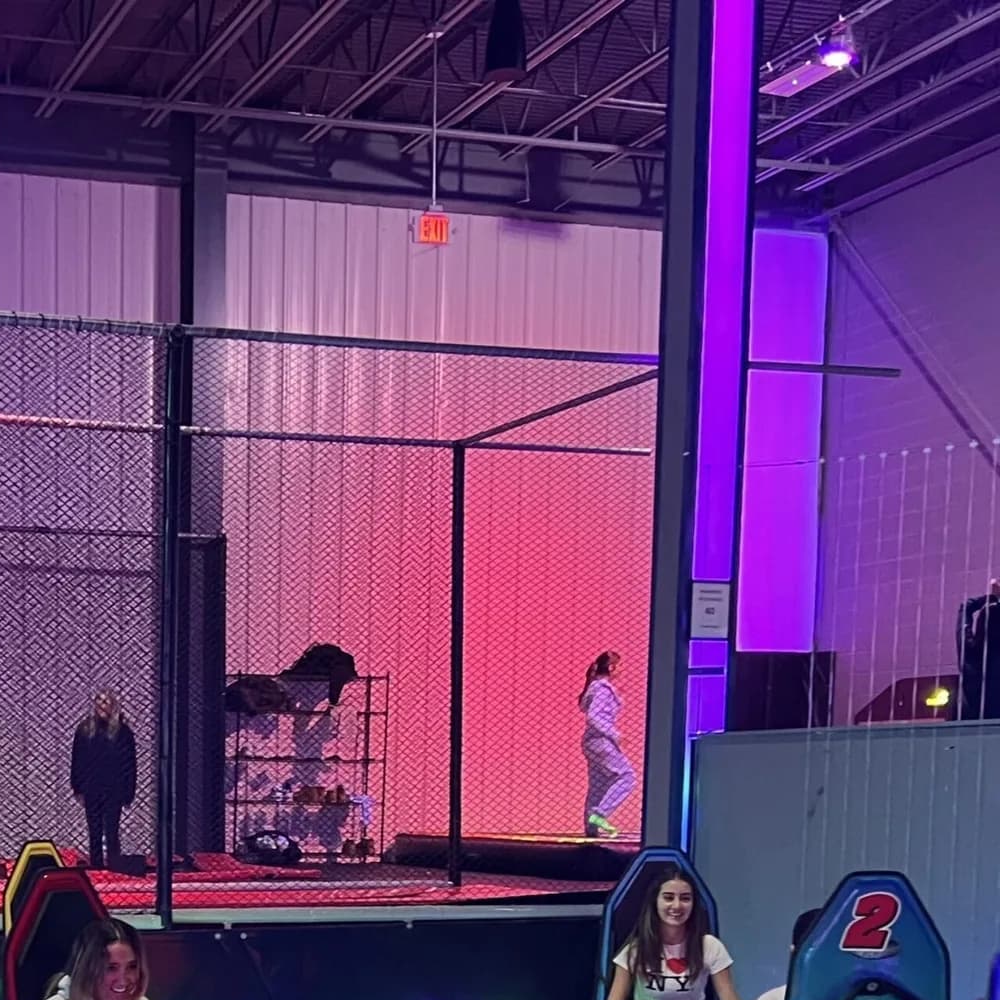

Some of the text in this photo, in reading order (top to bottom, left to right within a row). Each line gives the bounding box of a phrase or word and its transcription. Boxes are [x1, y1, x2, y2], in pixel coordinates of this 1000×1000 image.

[420, 216, 449, 242] EXIT
[839, 891, 901, 951] 2
[646, 973, 690, 992] NY
